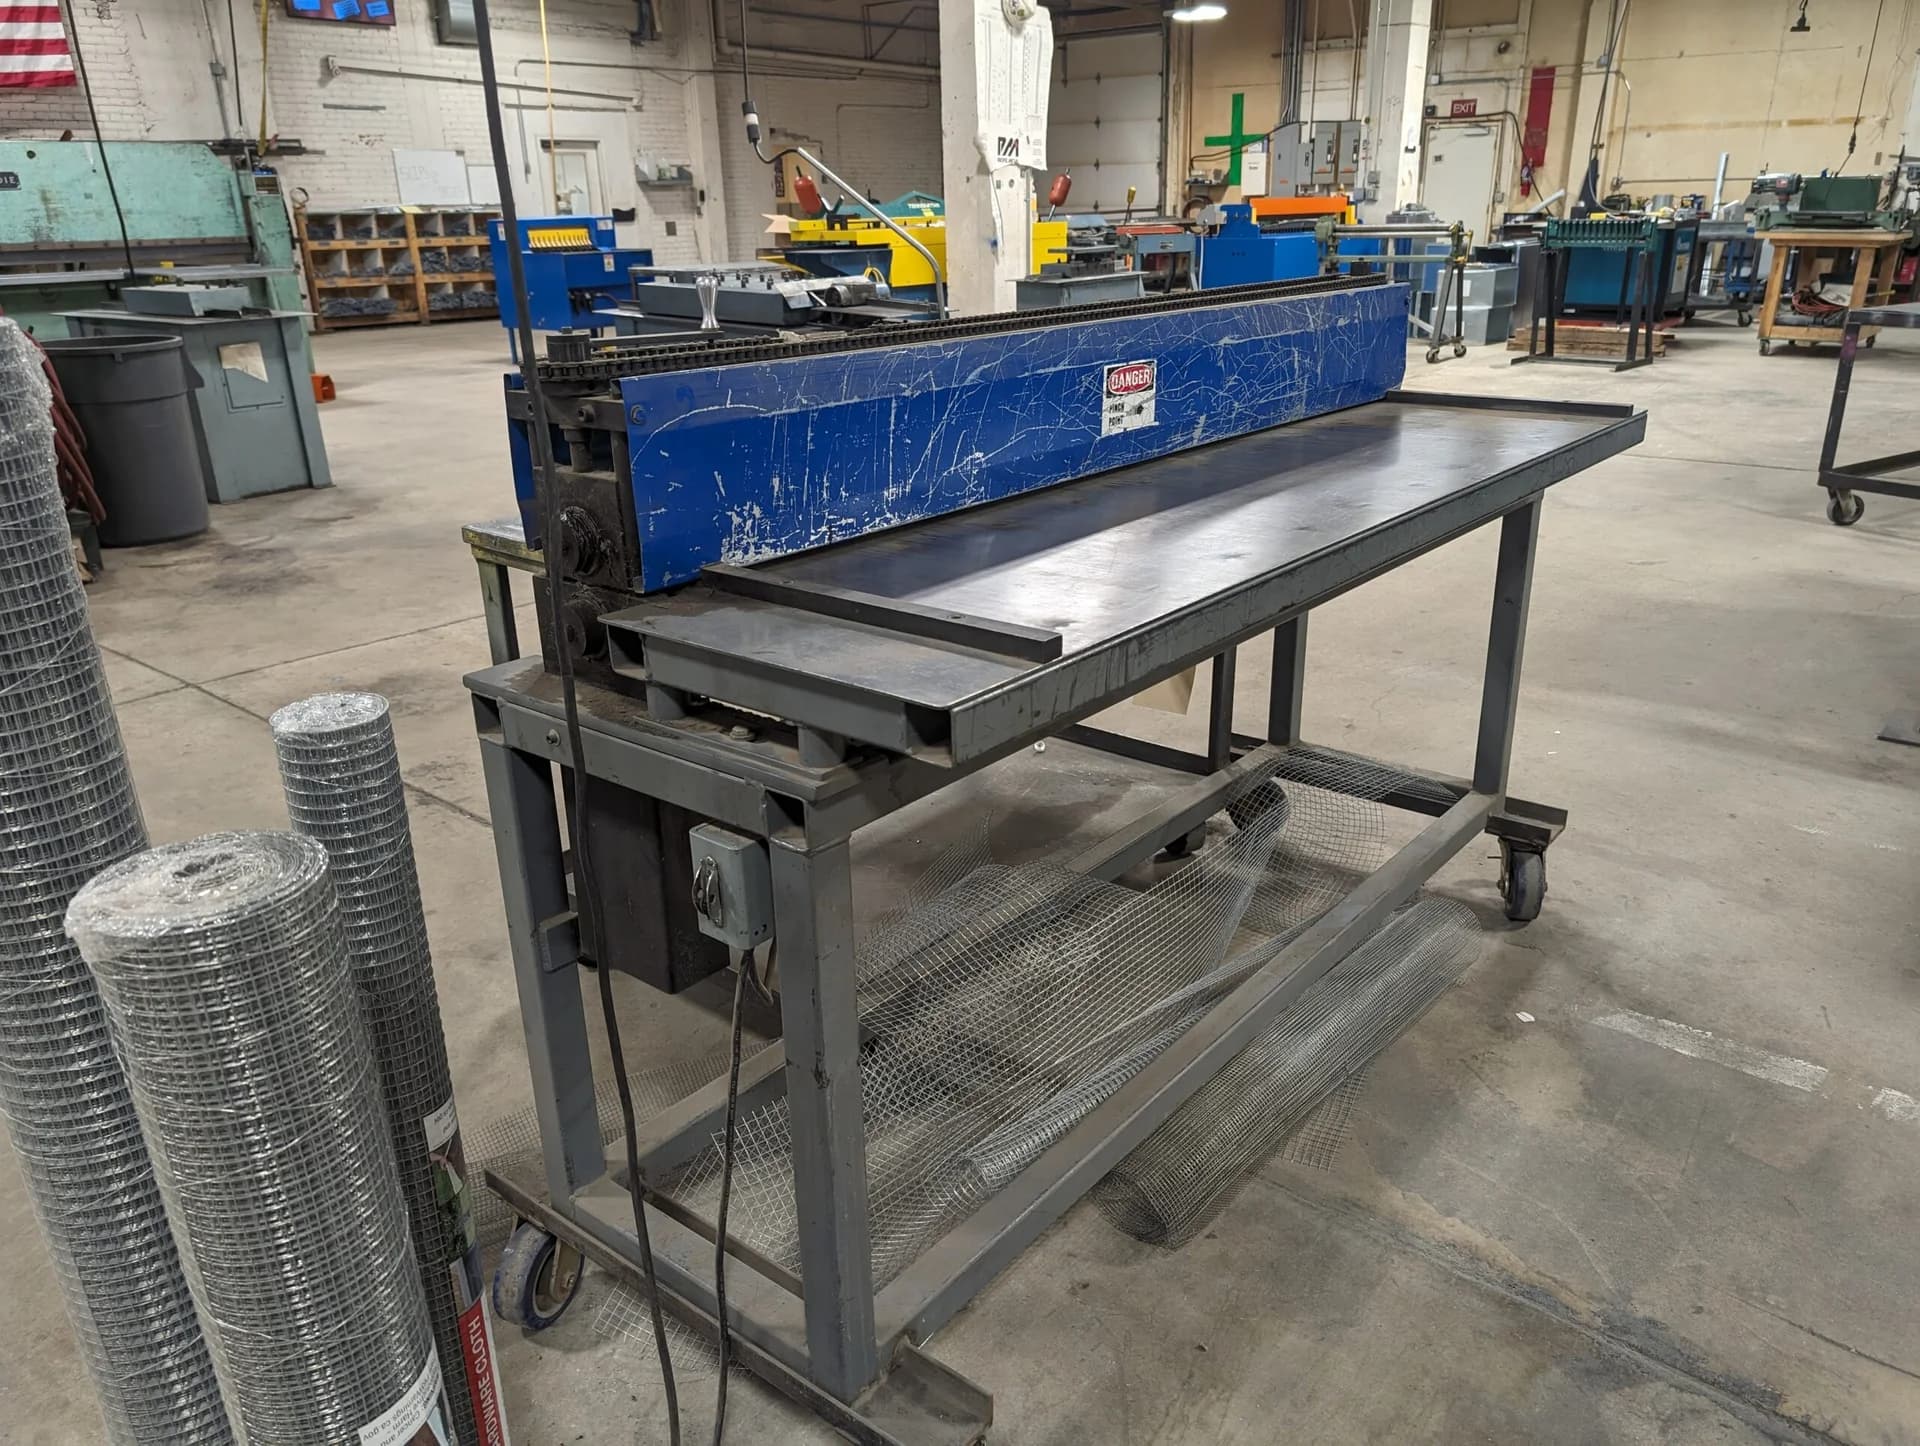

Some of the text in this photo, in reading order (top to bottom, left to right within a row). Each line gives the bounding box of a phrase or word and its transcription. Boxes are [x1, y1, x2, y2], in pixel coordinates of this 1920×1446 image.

[1453, 102, 1476, 113] EXIT
[1111, 368, 1151, 390] DANGER
[468, 1315, 488, 1374] CLOTH
[392, 1409, 413, 1431] Harm
[397, 1410, 421, 1437] Cancer
